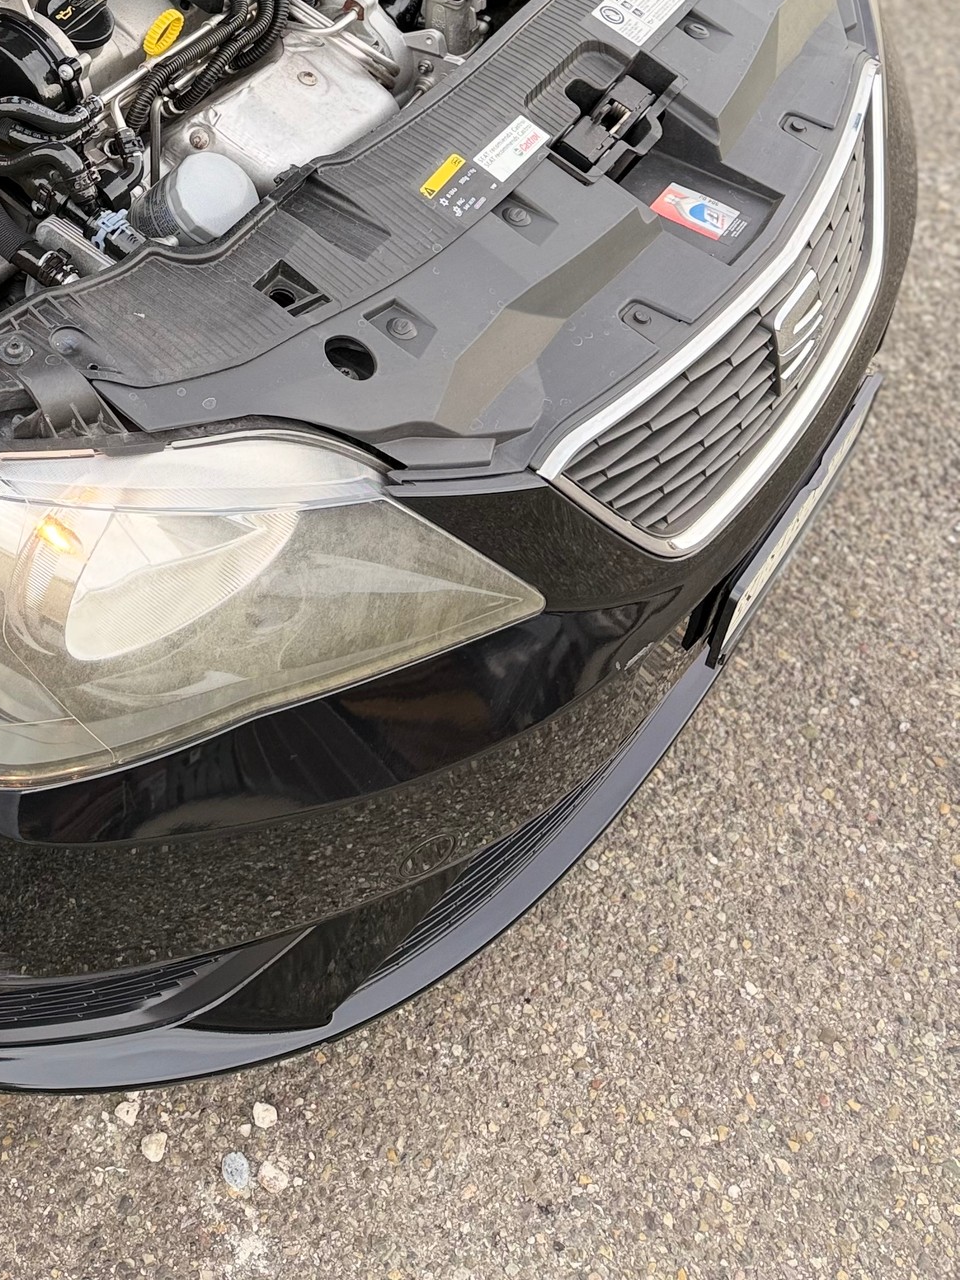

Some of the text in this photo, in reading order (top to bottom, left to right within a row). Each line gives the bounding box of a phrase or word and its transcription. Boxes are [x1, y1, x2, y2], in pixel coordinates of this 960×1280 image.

[520, 132, 541, 152] Castrol
[477, 151, 491, 163] SEAT
[483, 157, 496, 168] SEAT
